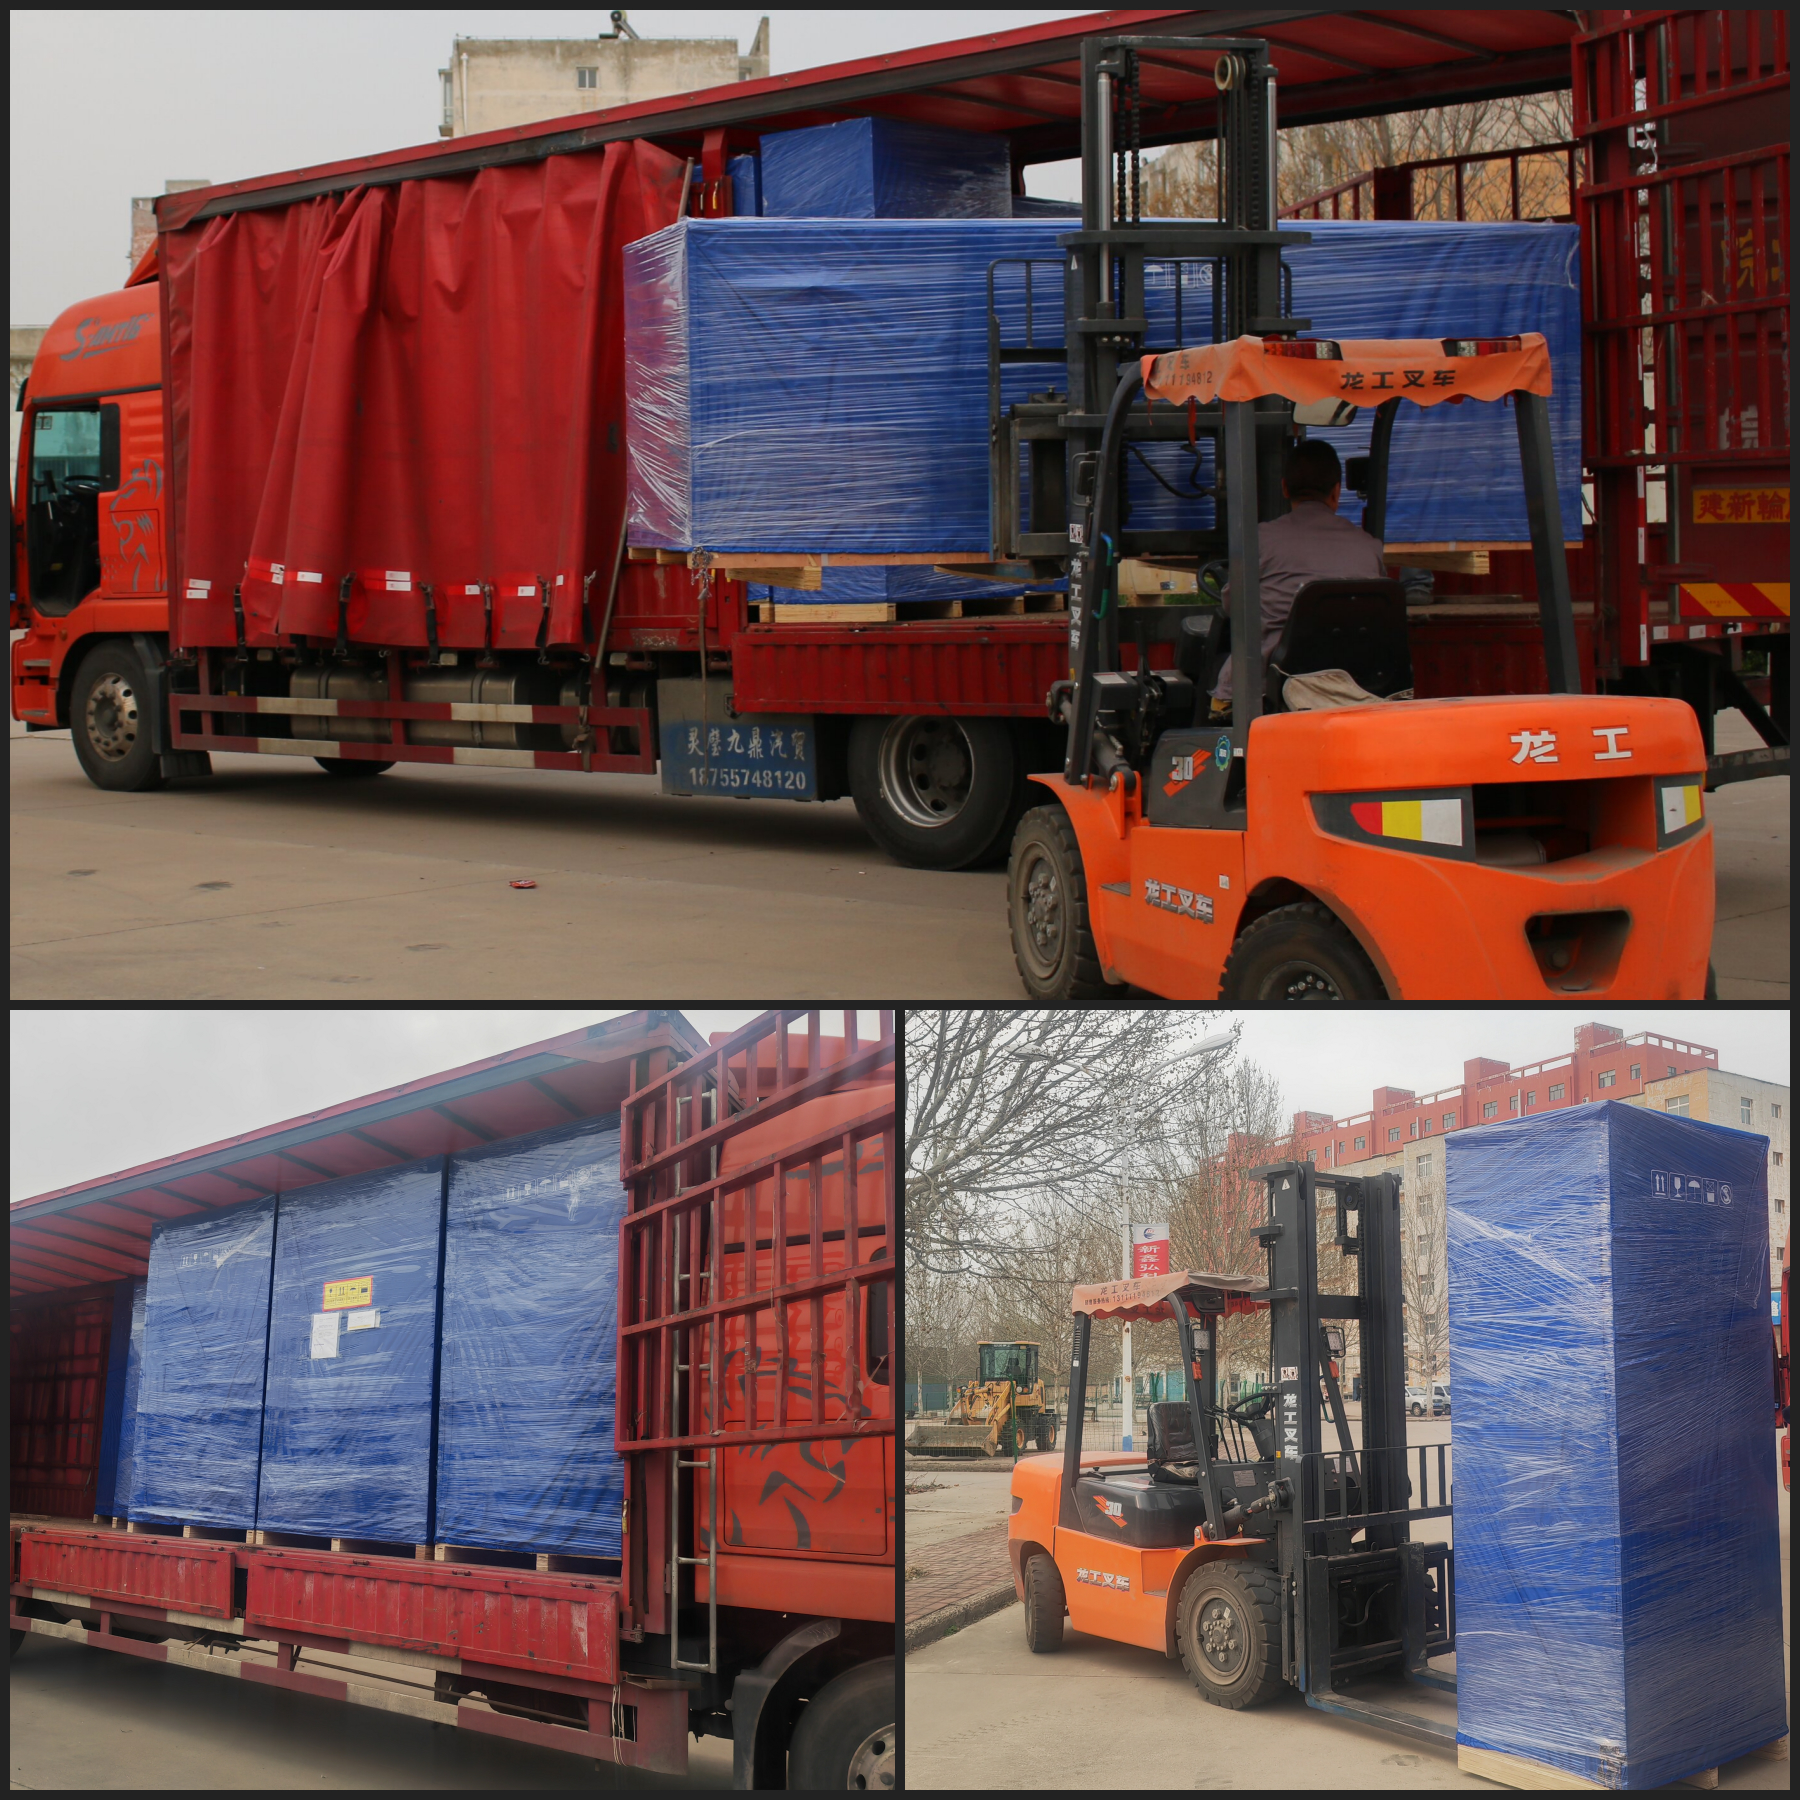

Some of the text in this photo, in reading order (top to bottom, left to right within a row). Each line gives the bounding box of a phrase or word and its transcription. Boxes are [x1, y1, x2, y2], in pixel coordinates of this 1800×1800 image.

[1340, 370, 1456, 390] 龙工叉车
[1697, 491, 1790, 521] 建新輪
[1070, 559, 1082, 650] 龙工叉车
[1510, 729, 1632, 764] 龙工
[689, 767, 806, 790] 18755748120
[1171, 756, 1194, 781] 30
[1144, 878, 1214, 924] 龙工叉车
[1100, 1281, 1141, 1296] 龙工叉车
[1283, 1393, 1298, 1460] 龙工叉车
[1104, 1501, 1123, 1517] 30
[1076, 1567, 1131, 1592] 龙工叉车
